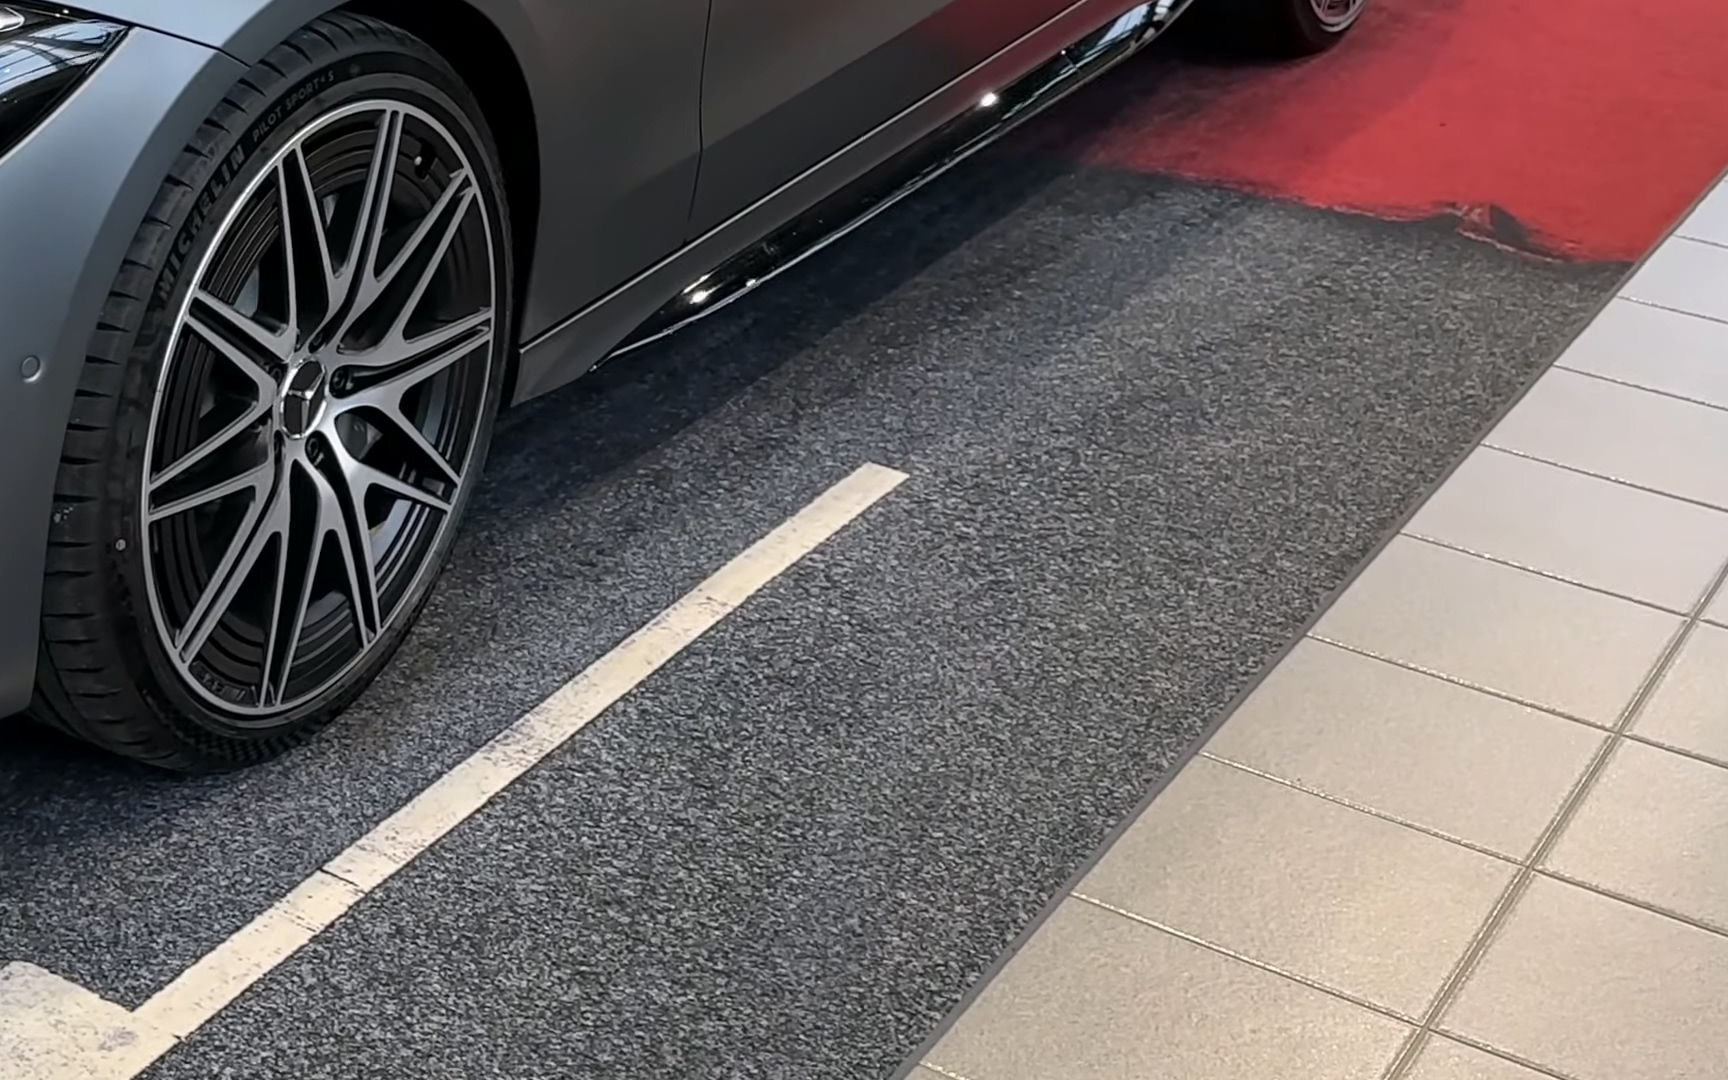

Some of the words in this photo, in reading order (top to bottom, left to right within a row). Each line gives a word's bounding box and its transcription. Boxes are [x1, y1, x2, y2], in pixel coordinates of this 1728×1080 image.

[158, 144, 247, 300] MICHELIN
[252, 105, 282, 143] PILOT
[285, 78, 320, 111] SPORT
